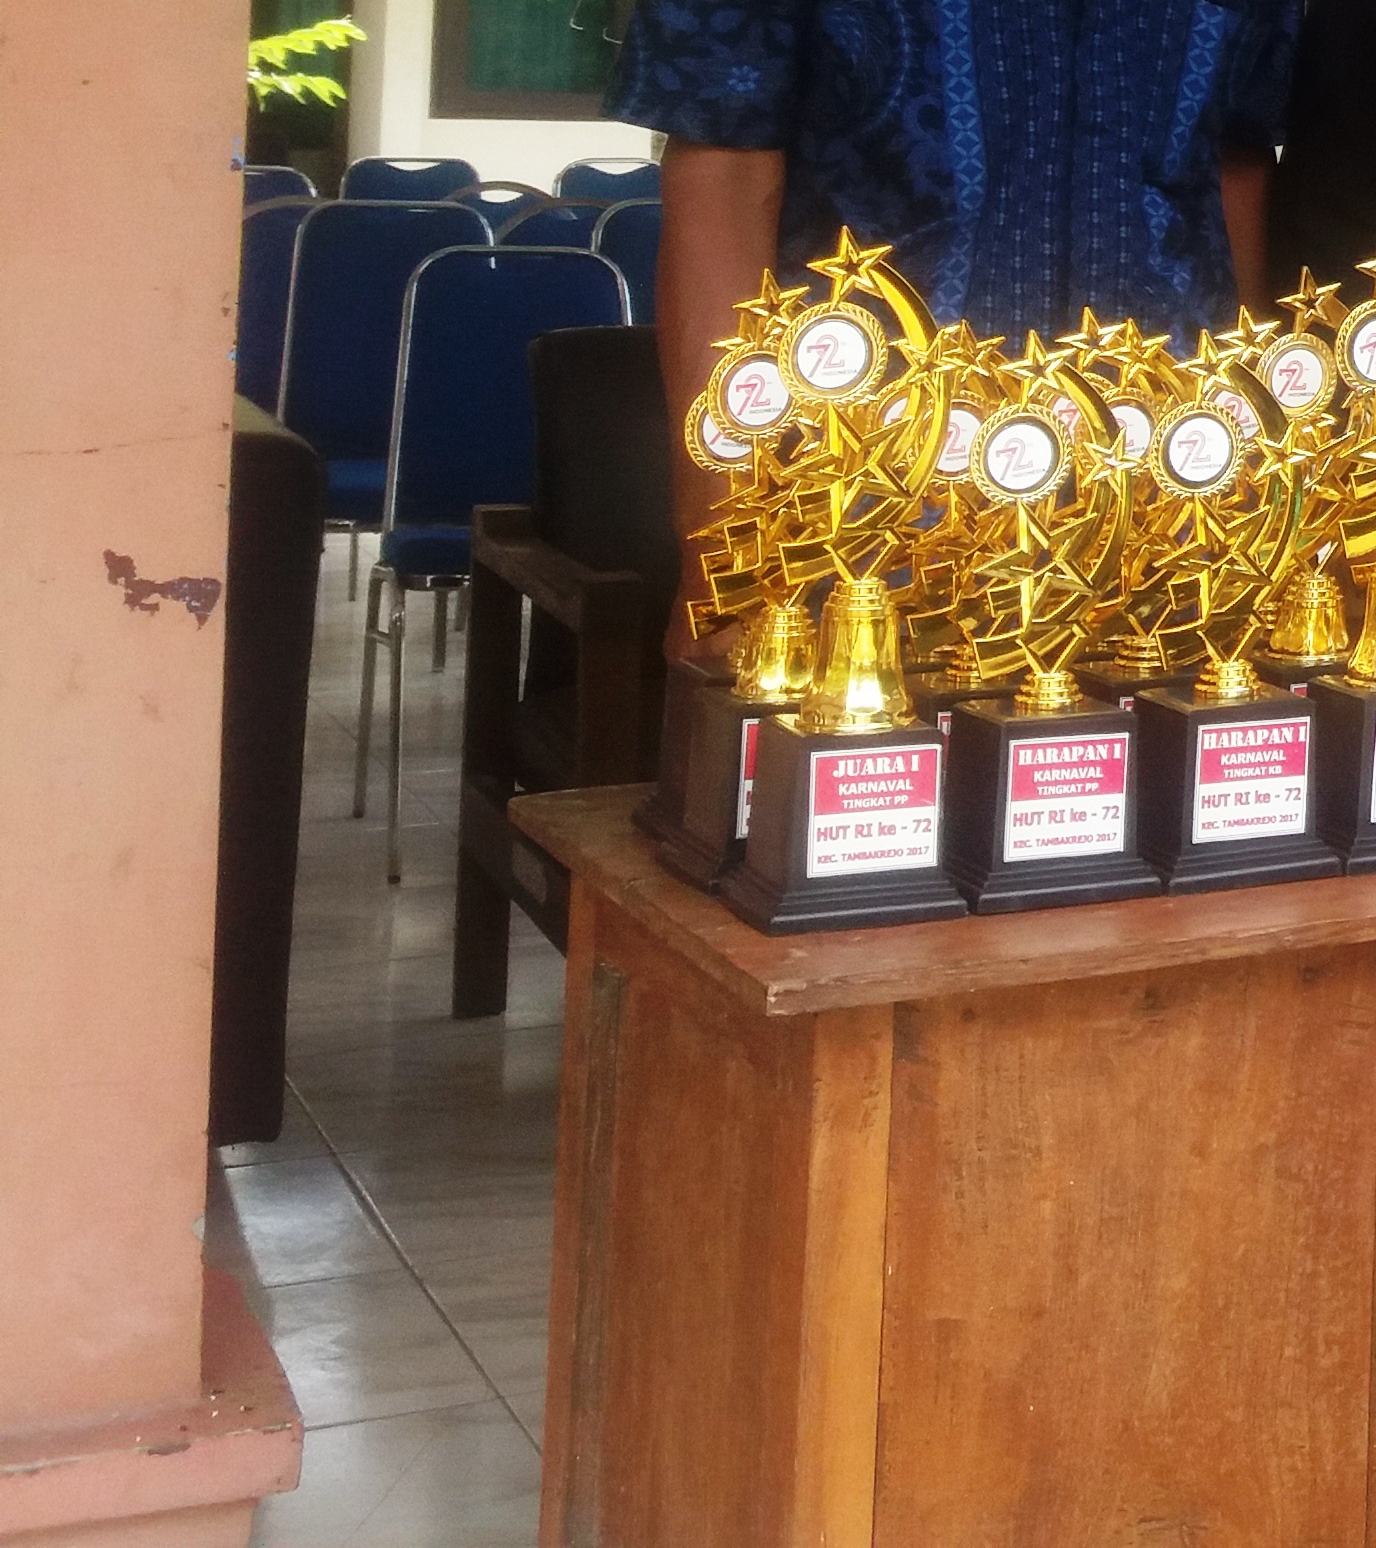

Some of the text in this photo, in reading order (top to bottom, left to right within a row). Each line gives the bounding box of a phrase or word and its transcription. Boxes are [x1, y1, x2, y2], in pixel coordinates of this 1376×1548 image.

[806, 334, 845, 378] 72
[1278, 360, 1307, 397] 72
[736, 374, 771, 416] 72
[996, 438, 1033, 480] 72
[1177, 430, 1211, 471] 72
[1203, 727, 1295, 750] HARAPAN
[1018, 745, 1111, 766] HARAPAN
[1220, 750, 1286, 766] KARNAVAL
[833, 755, 905, 778] JUARA
[1033, 766, 1104, 783] KARNAVAL
[1223, 766, 1282, 779] TINGKAT KB
[838, 778, 914, 796] KARNAVAL
[1037, 783, 1098, 796] TINGKAT PP
[842, 795, 909, 810] TINGKAT PP
[1201, 793, 1231, 809] HUT
[1235, 792, 1251, 805] RI
[1255, 789, 1270, 804] ke
[1285, 788, 1301, 801] 72
[1013, 811, 1044, 827] HUT
[1048, 809, 1065, 824] RI
[1070, 807, 1087, 823] ke
[1102, 806, 1120, 820] 72
[1223, 816, 1276, 829] TAMBAKREJO
[1279, 813, 1299, 823] 2017
[817, 825, 849, 842] HUT
[855, 823, 873, 838] RI
[878, 821, 896, 836] ke
[912, 818, 932, 834] 72
[1036, 835, 1093, 847] TAMBAKREJO
[1096, 833, 1117, 842] 2017
[842, 848, 903, 862] TAMBAKREJO
[906, 846, 929, 857] 2017
